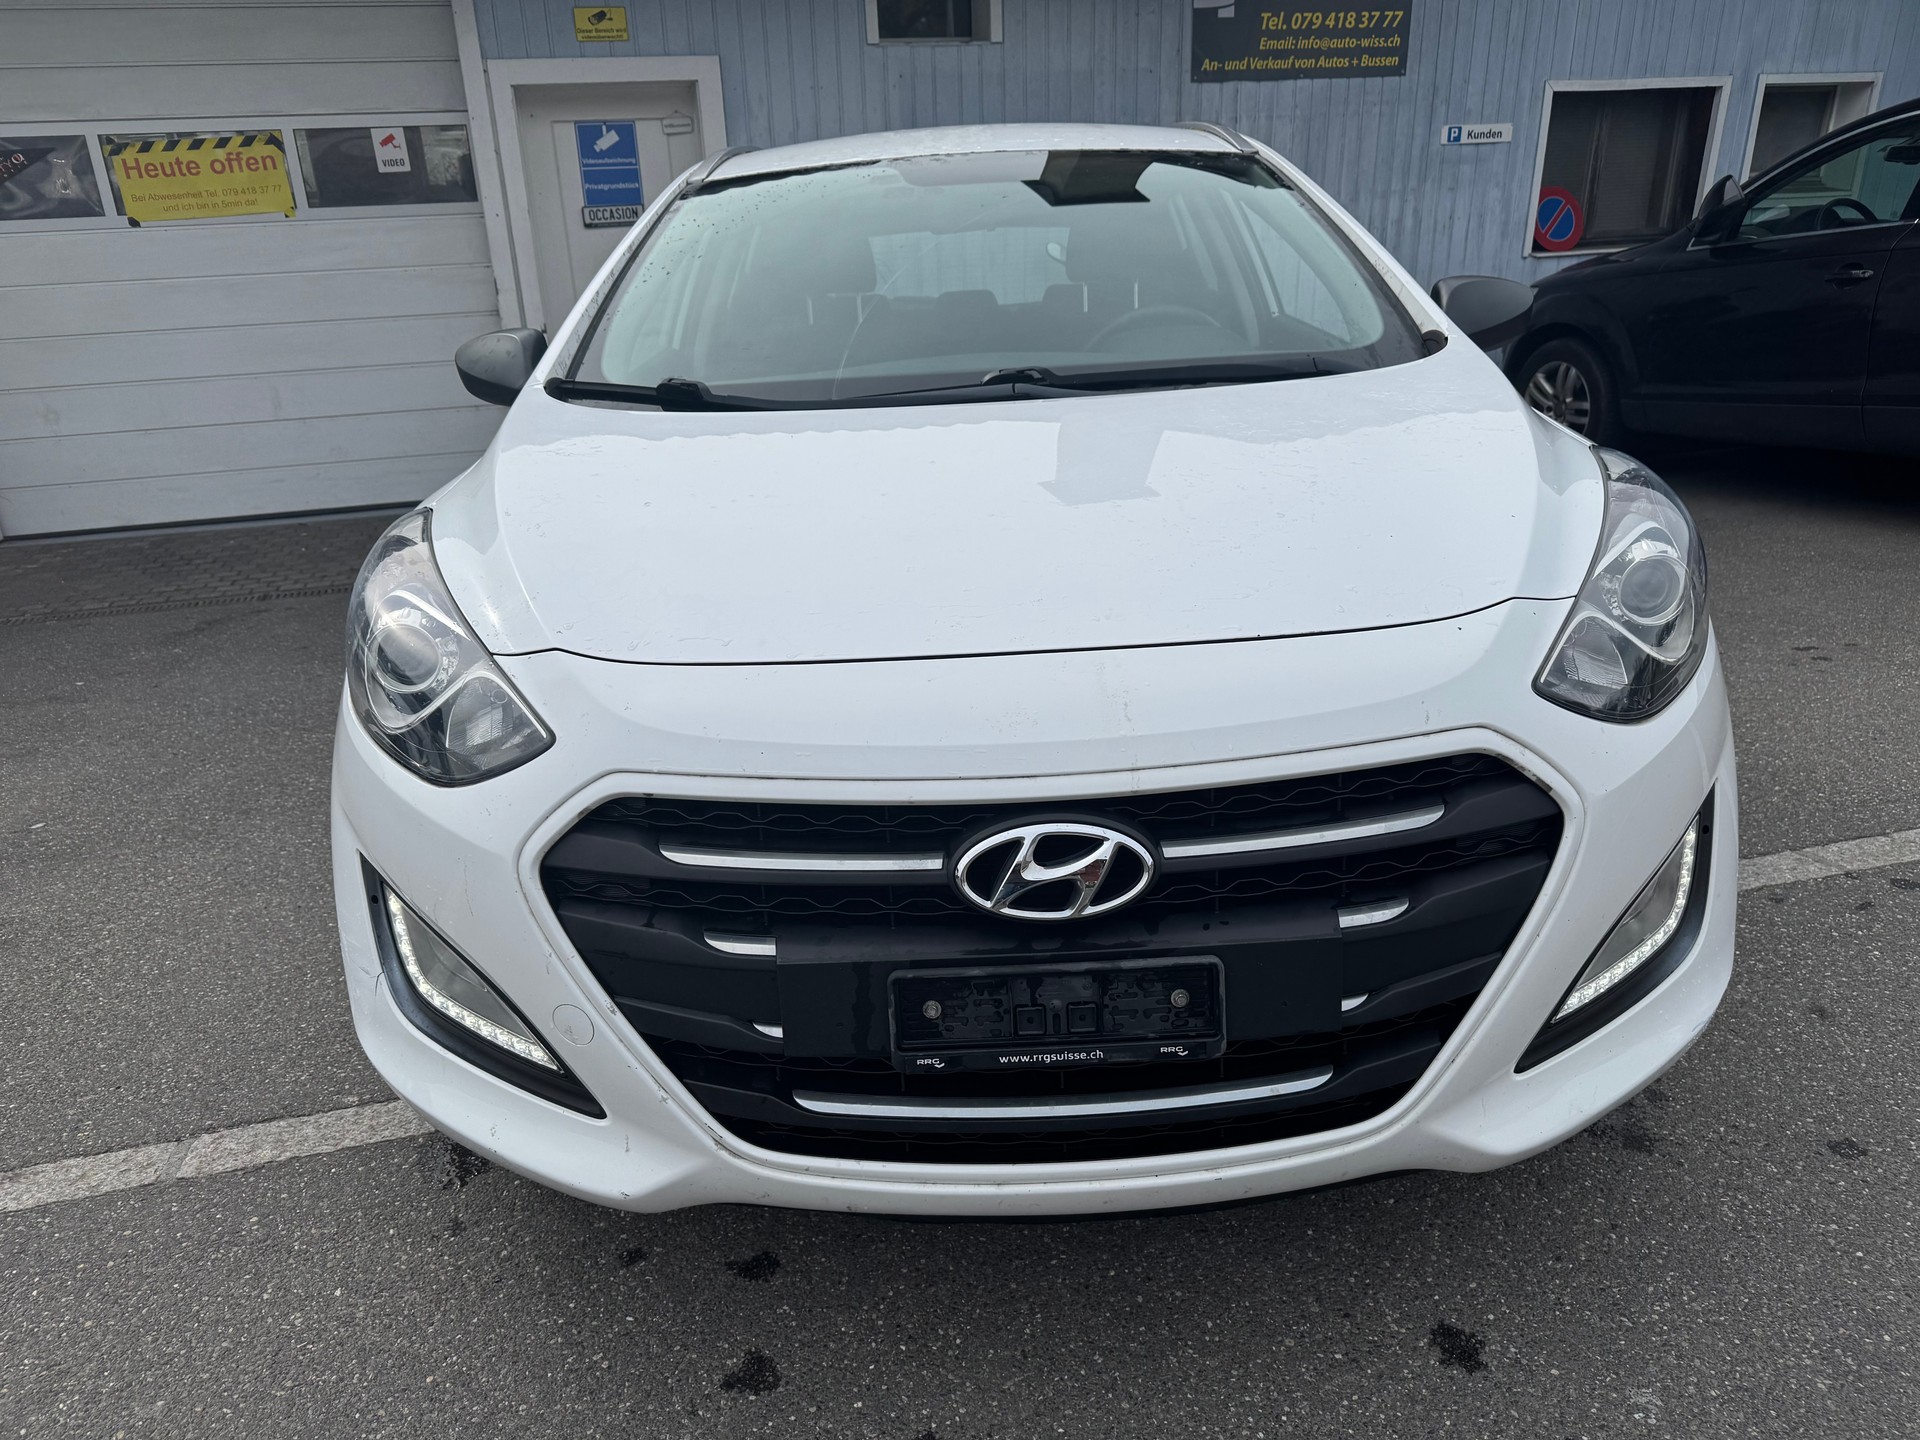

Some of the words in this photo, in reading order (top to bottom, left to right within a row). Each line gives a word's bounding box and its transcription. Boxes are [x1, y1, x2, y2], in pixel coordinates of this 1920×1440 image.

[1261, 11, 1287, 30] Tel.
[1291, 12, 1322, 29] 079
[1325, 11, 1357, 29] 418
[1359, 11, 1380, 28] 37
[1382, 11, 1404, 28] 77
[1259, 36, 1296, 50] Email:
[1297, 34, 1400, 50] info@auto-wiss.ch
[1201, 58, 1223, 71] An-
[1224, 56, 1248, 71] und
[1249, 55, 1295, 70] Verkauf
[1295, 57, 1315, 69] von
[1317, 54, 1349, 69] Autos
[1352, 57, 1359, 67] +
[1361, 54, 1399, 67] Bussen
[1467, 129, 1502, 140] Kunden
[121, 156, 201, 179] Heute
[209, 152, 278, 175] offen
[382, 158, 405, 167] VIDEO
[131, 193, 146, 202] Bei
[148, 190, 203, 201] Abwesenheit
[205, 189, 220, 198] Tel.
[222, 187, 239, 197] 079
[240, 186, 258, 195] 418
[259, 185, 269, 194] 37
[271, 184, 282, 193] 77
[163, 202, 180, 212] und
[181, 201, 195, 211] ich
[196, 201, 209, 210] bin
[211, 200, 220, 209] in
[221, 199, 243, 208] 5min
[244, 198, 258, 206] da!
[588, 207, 639, 221] OCCASION
[916, 1058, 940, 1066] RRG
[999, 1049, 1104, 1063] www.rrgsuisse.ch
